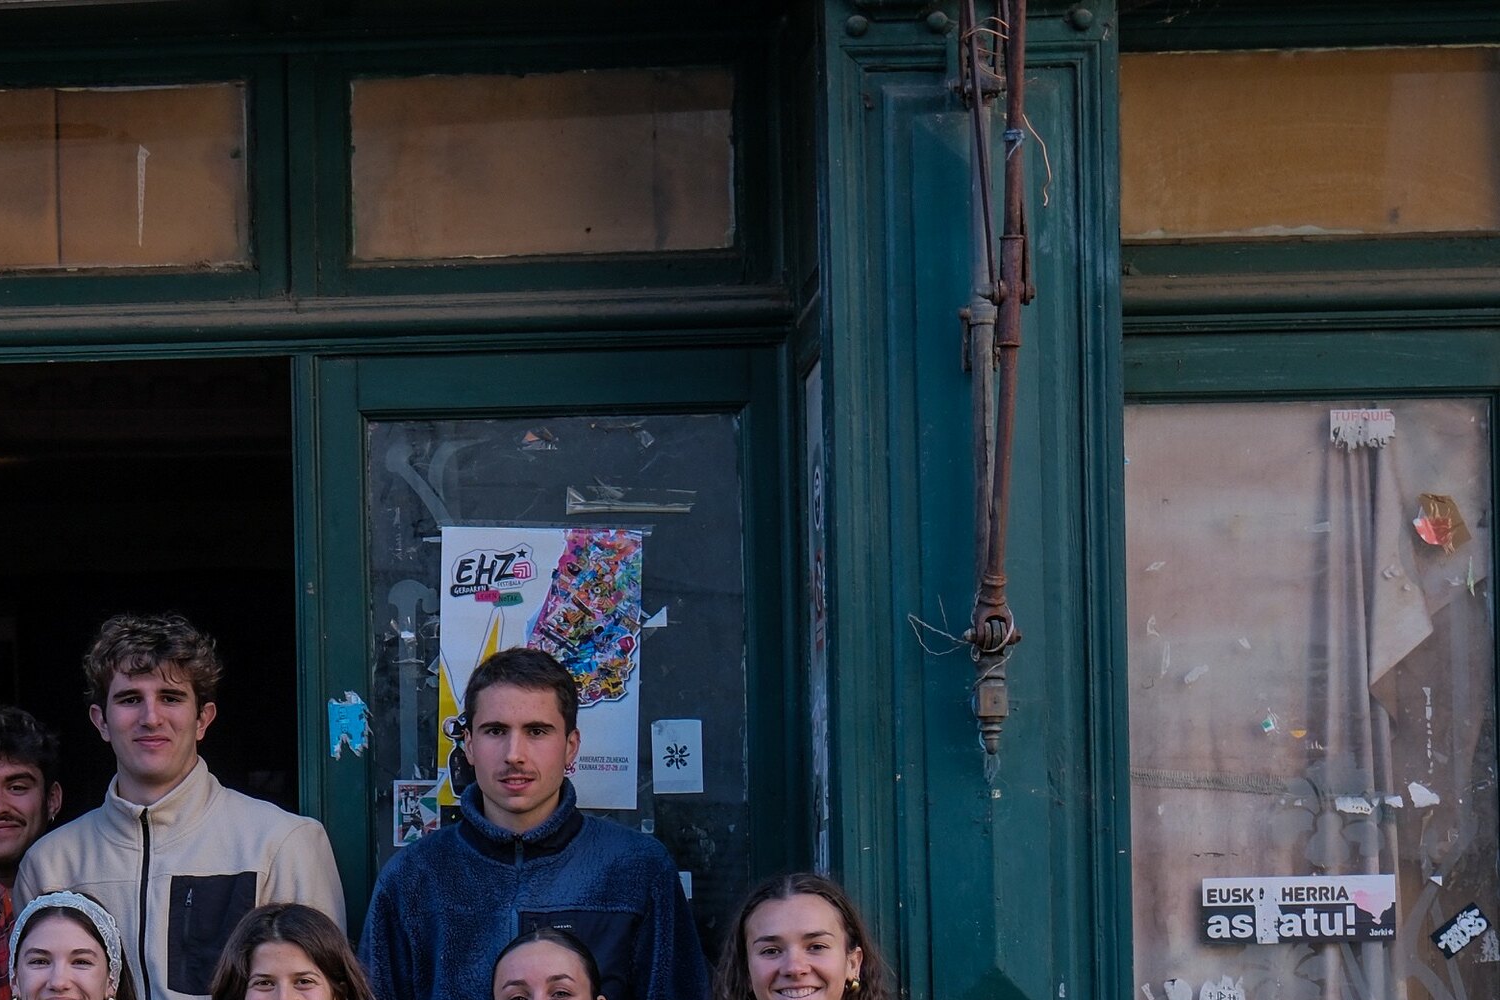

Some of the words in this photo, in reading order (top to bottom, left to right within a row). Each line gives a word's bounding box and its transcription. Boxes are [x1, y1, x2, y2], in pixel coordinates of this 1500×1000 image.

[456, 552, 517, 586] EHZ
[1281, 886, 1349, 903] HERRIA
[1207, 904, 1356, 938] asatu!
